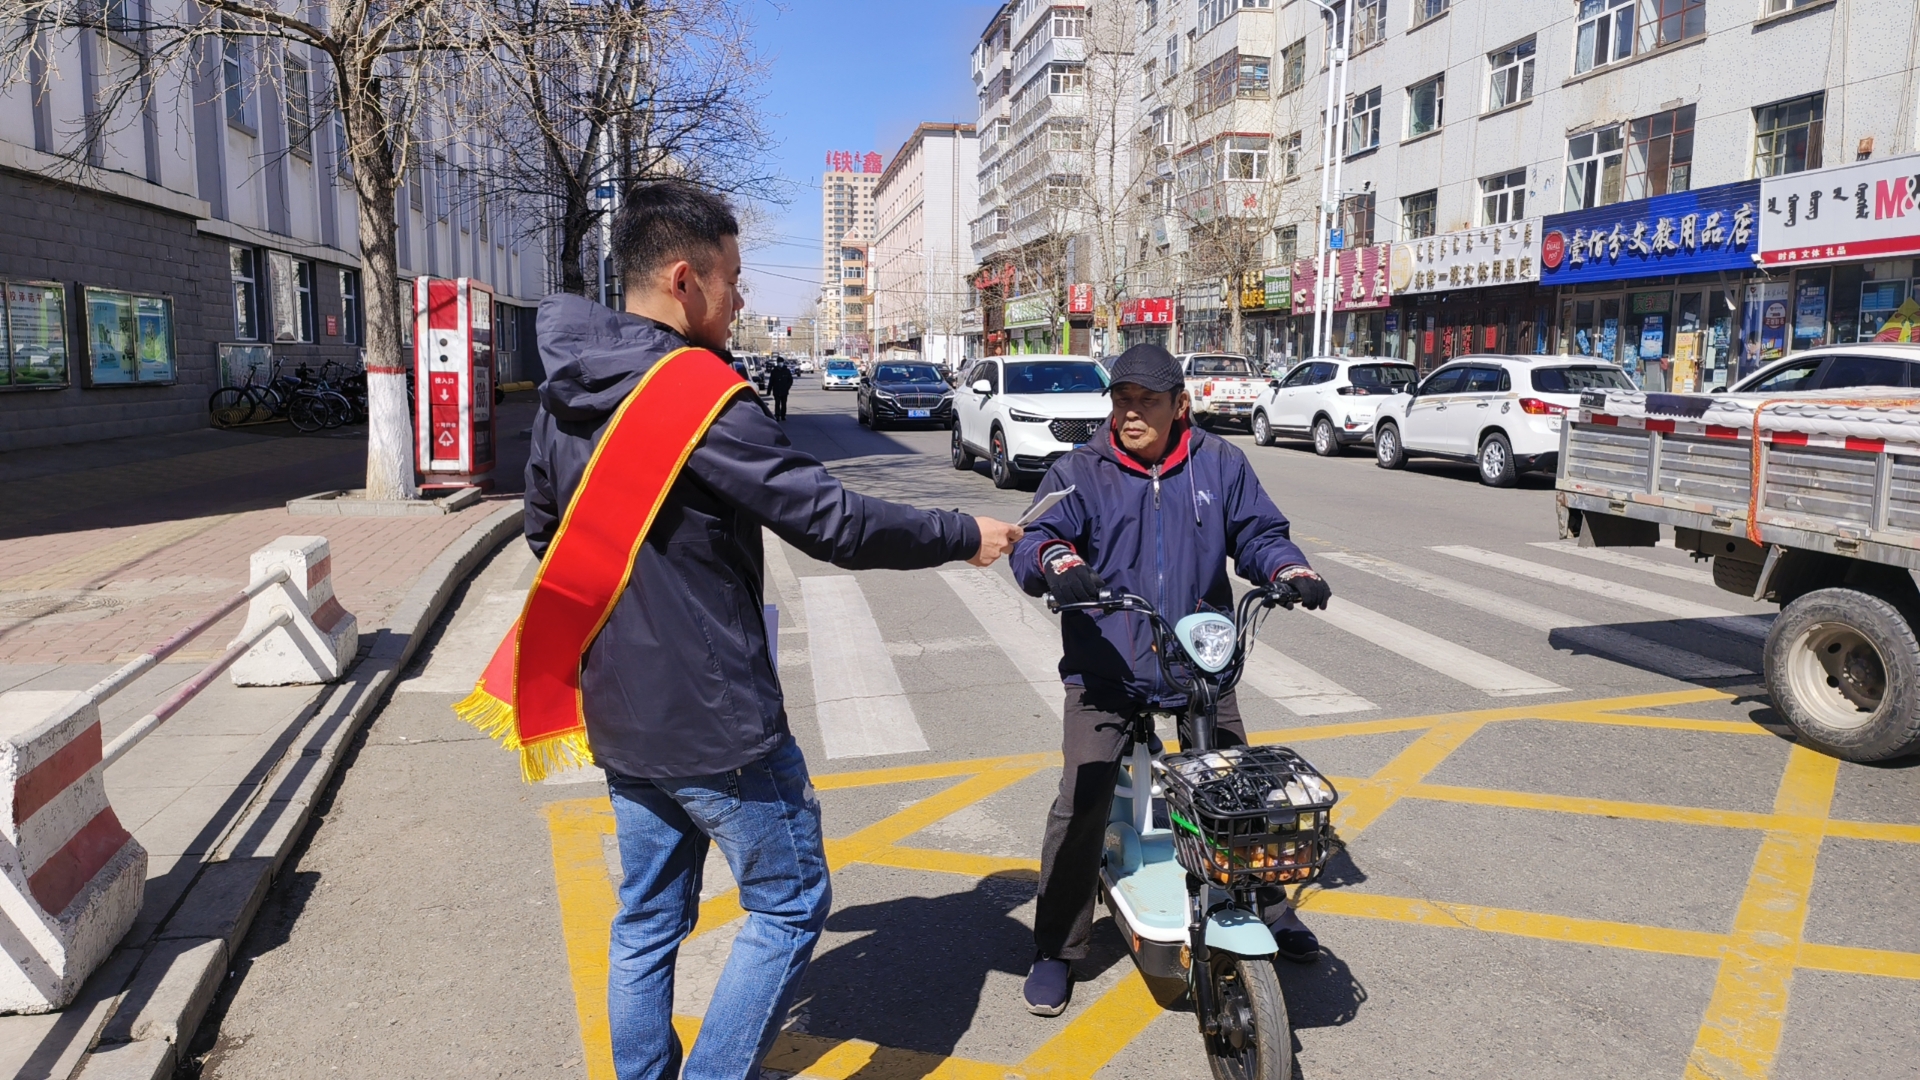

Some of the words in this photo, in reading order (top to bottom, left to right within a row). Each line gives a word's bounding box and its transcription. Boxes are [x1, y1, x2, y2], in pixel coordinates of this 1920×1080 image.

[1568, 202, 1754, 264] 壹佰分文教用品店
[1778, 251, 1797, 260] 时尚
[1801, 248, 1820, 258] 文体
[1826, 246, 1846, 257] 礼品
